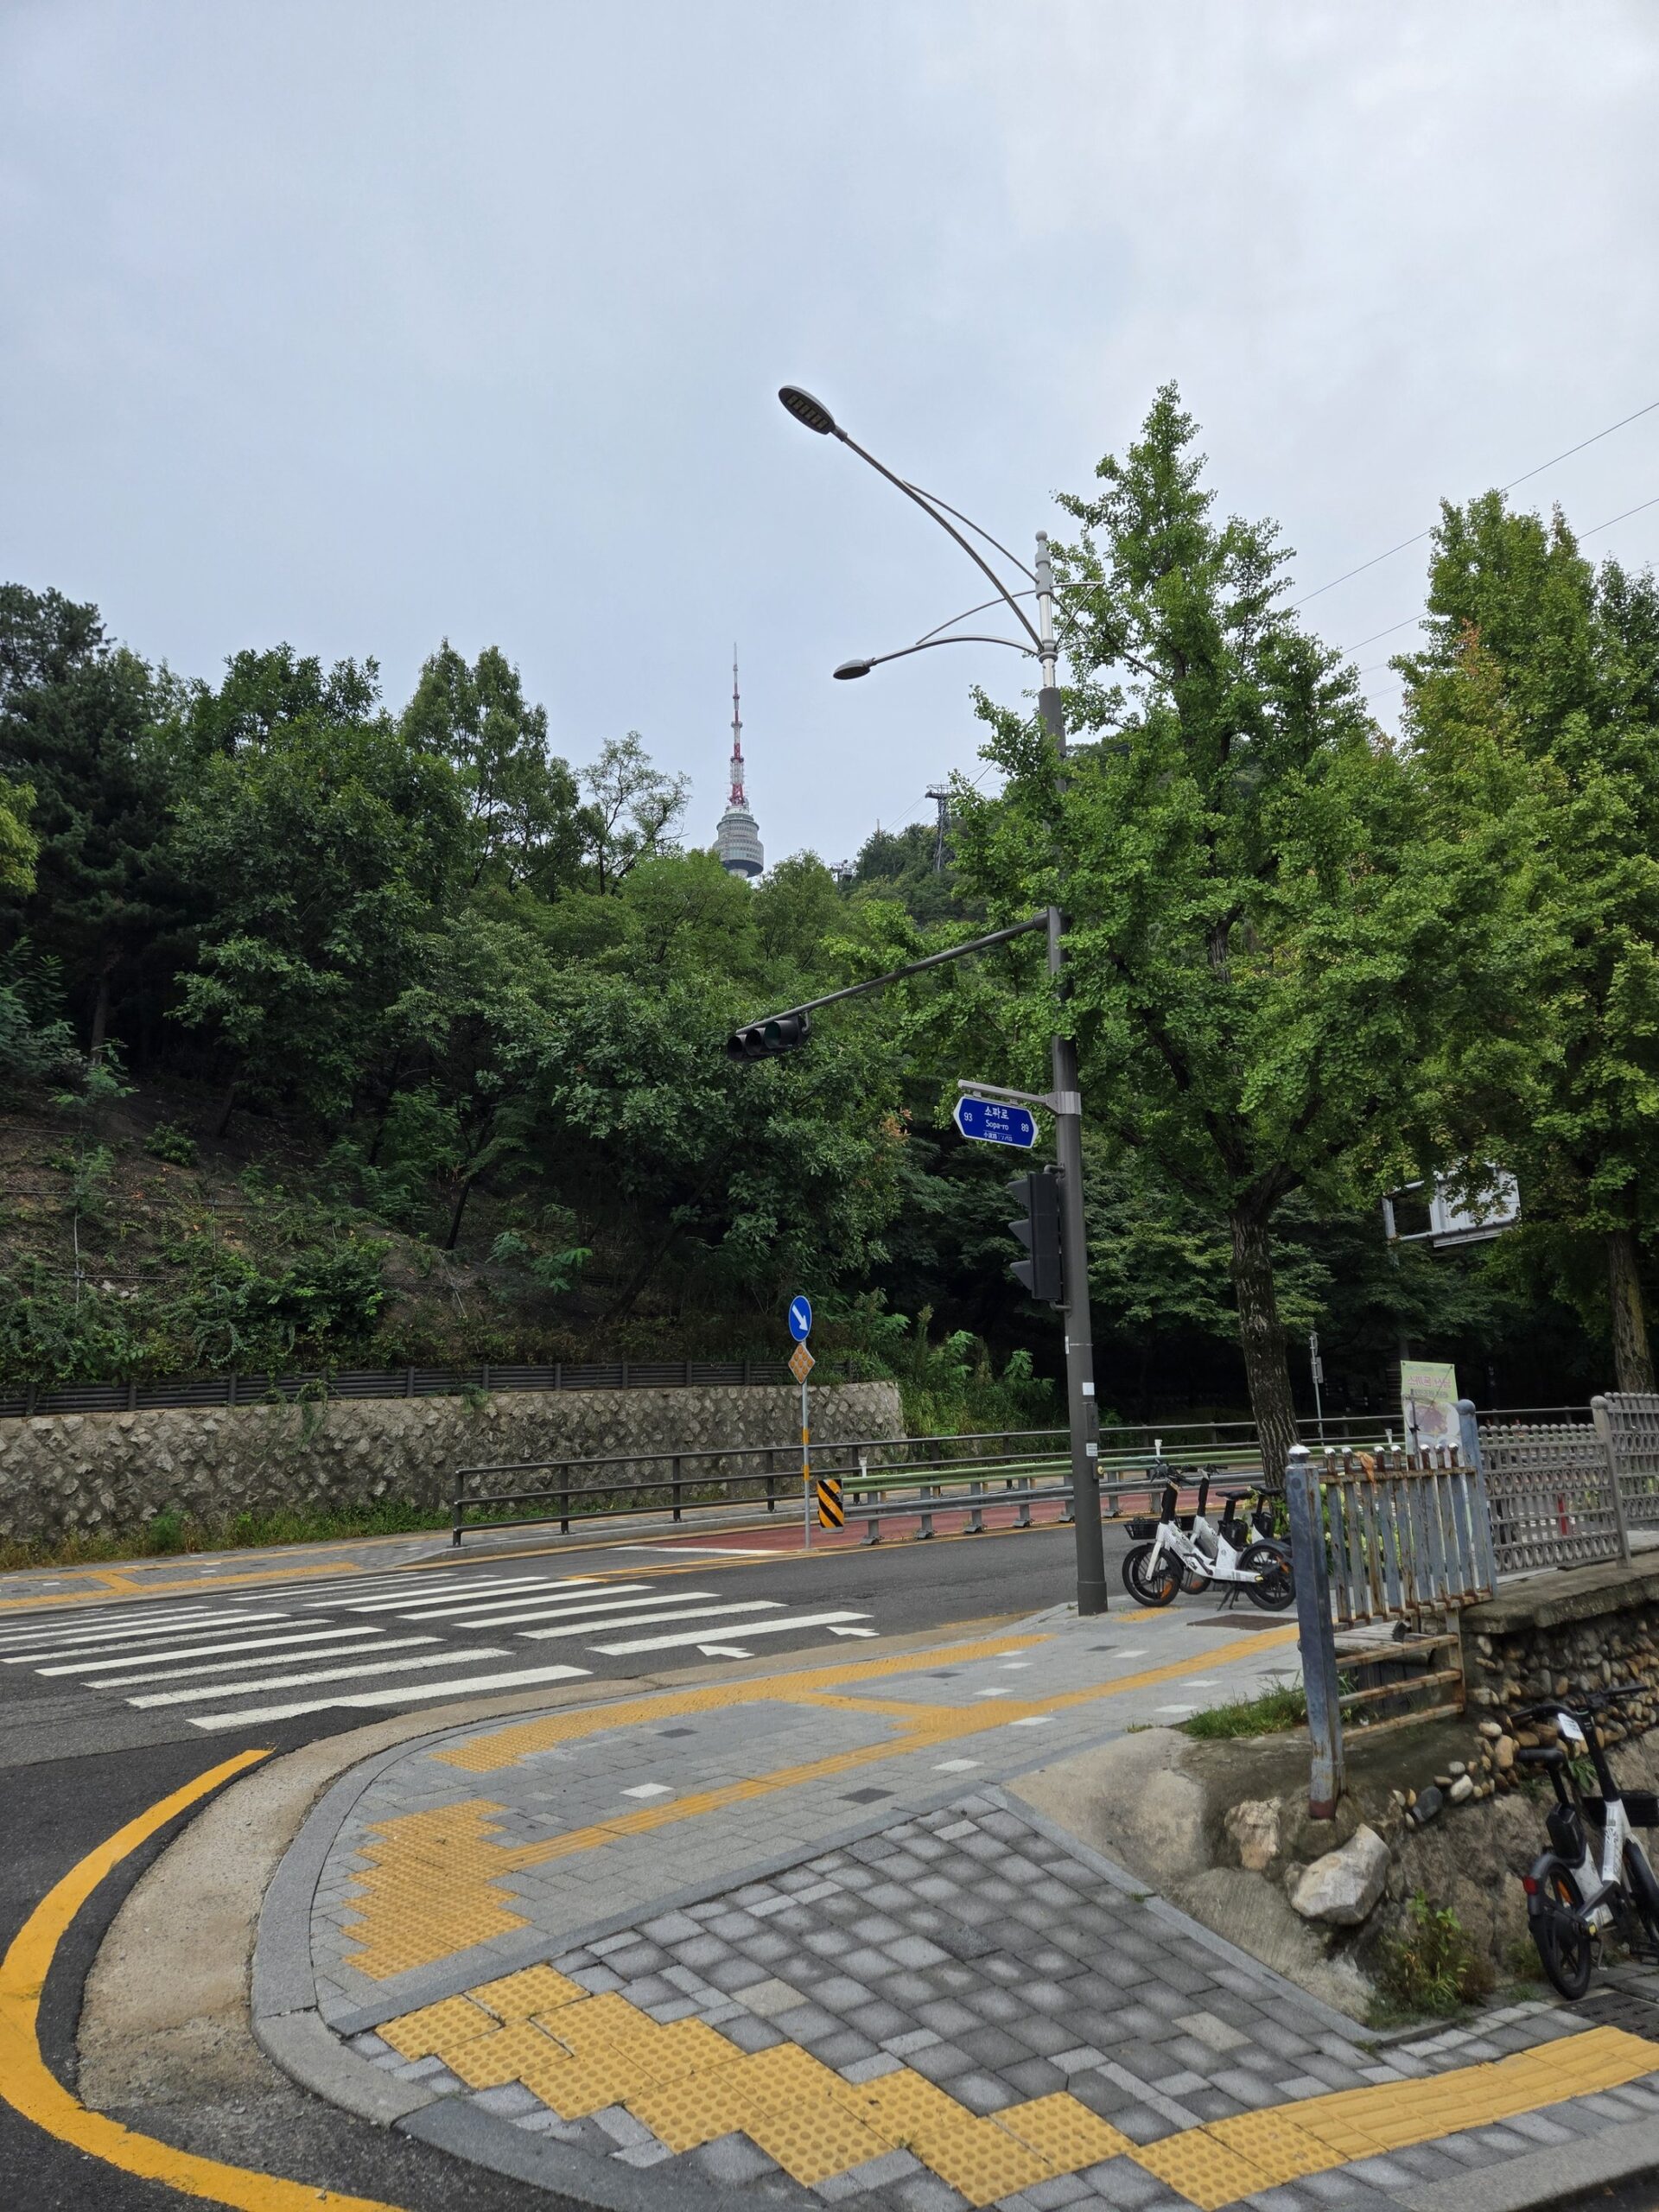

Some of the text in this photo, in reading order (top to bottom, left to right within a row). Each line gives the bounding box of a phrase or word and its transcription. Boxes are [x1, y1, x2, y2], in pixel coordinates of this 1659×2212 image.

[963, 1112, 973, 1122] 93
[984, 1106, 1009, 1120] 소파로
[985, 1119, 1009, 1130] Sopa-ro
[1020, 1123, 1029, 1133] 89
